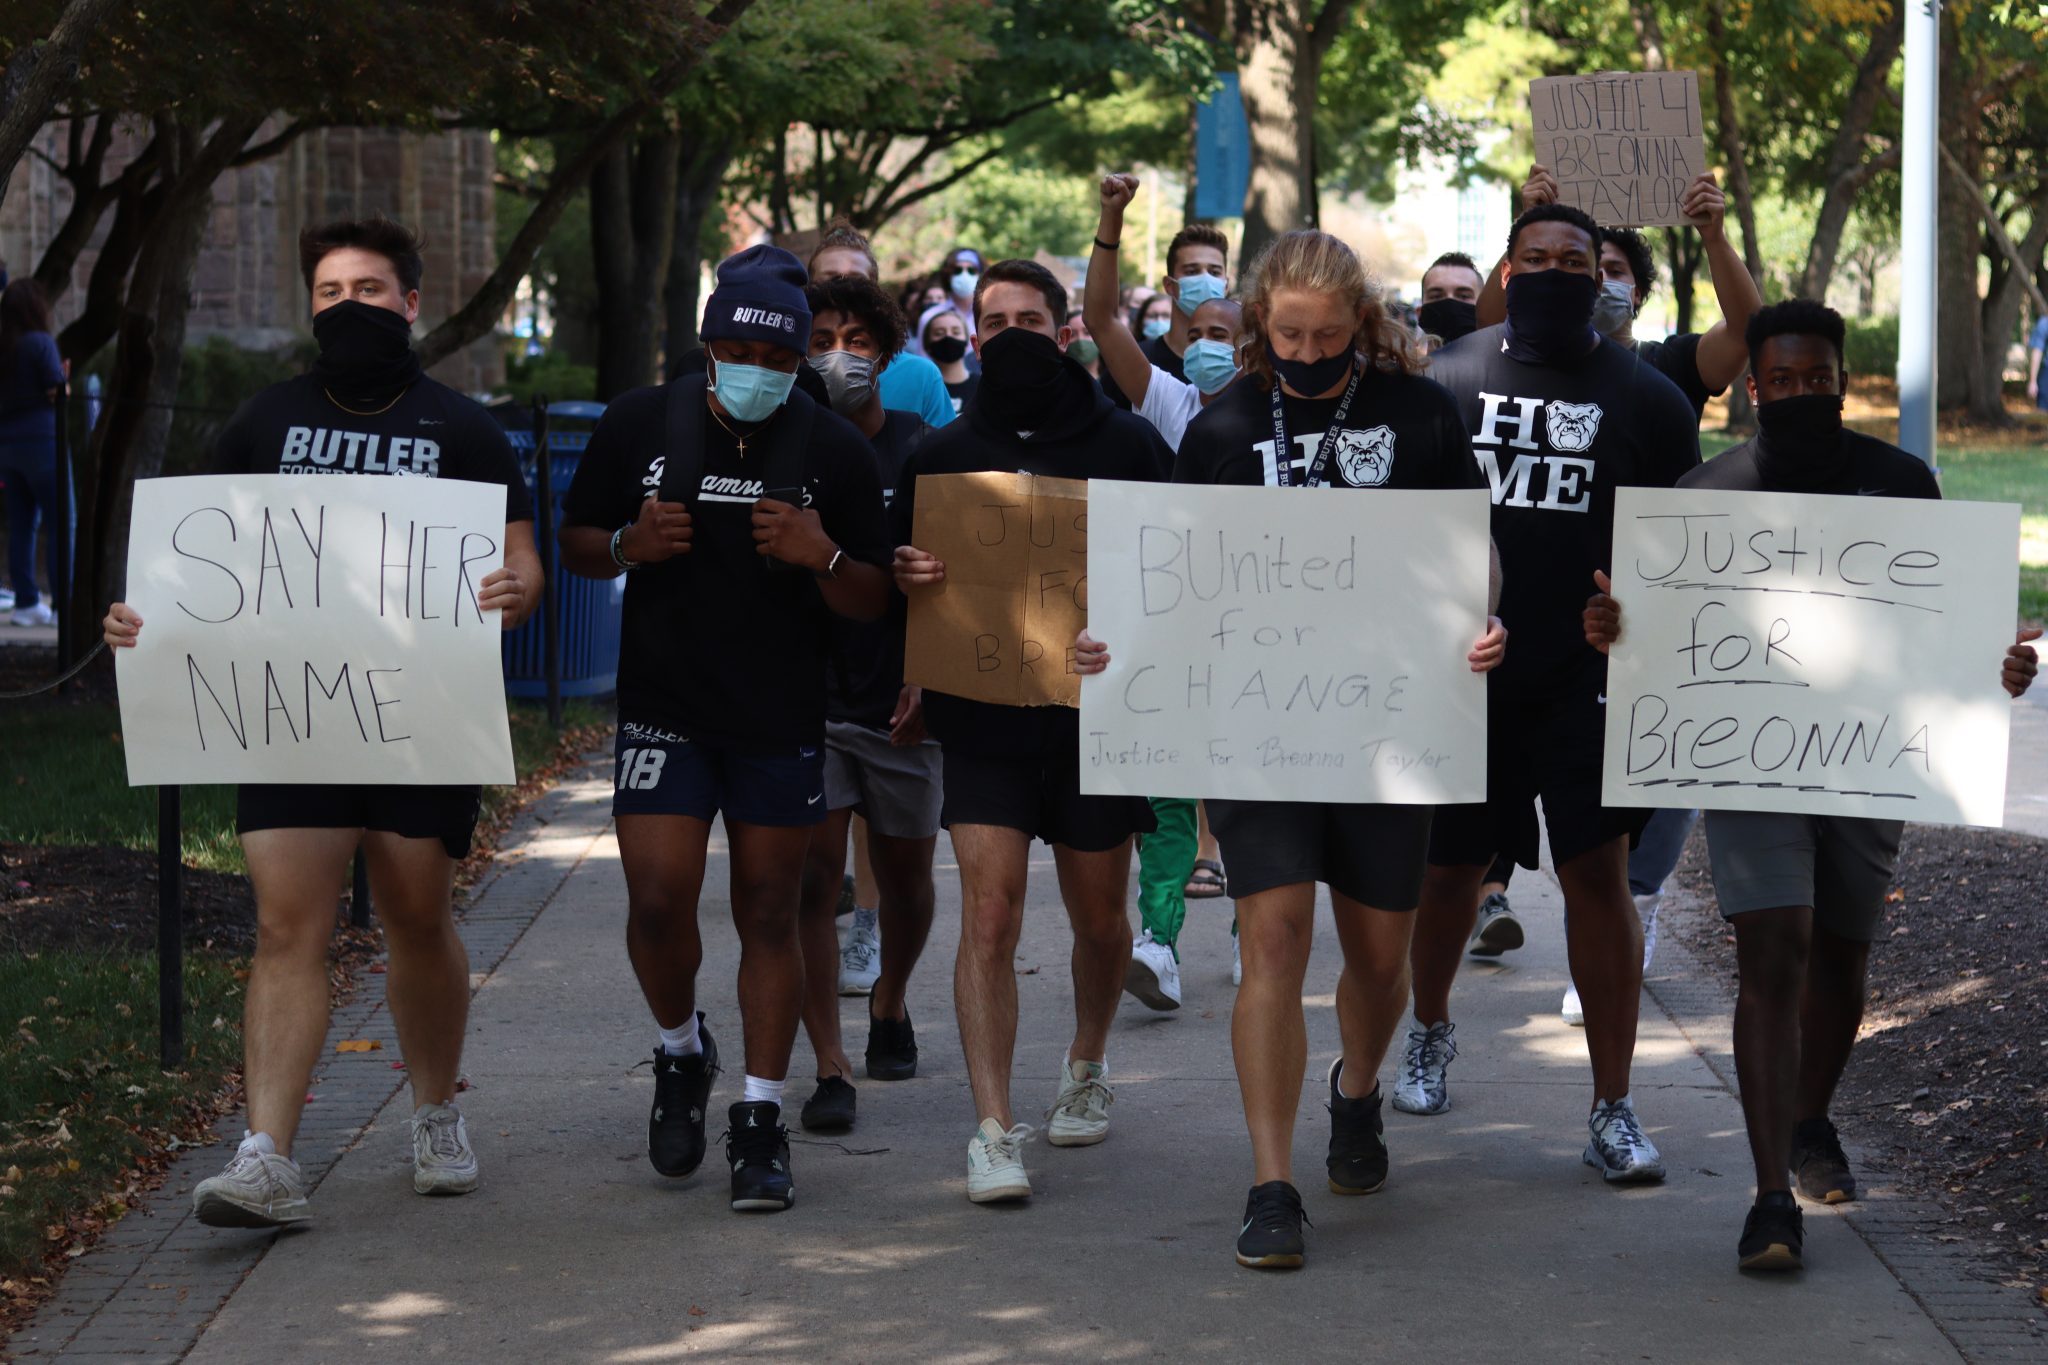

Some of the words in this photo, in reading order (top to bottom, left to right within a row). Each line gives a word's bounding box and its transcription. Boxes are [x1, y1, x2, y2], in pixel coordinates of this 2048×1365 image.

[1543, 78, 1650, 132] JUSTICE
[1658, 77, 1692, 138] 4
[1552, 133, 1691, 178] BREONNA
[1562, 175, 1687, 225] TAYLOR
[732, 306, 783, 328] BUTLER
[1340, 375, 1359, 411] BUTLER
[1274, 420, 1286, 456] BUTLER
[1319, 424, 1340, 461] BUTLER
[1471, 391, 1545, 451] H
[280, 426, 440, 478] BUTLER
[1472, 449, 1596, 513] ME
[173, 505, 324, 623] SAY
[379, 511, 496, 627] HER
[1140, 525, 1355, 617] BUnited
[1210, 608, 1317, 651] for
[186, 653, 412, 751] NAME
[1123, 663, 1409, 714] CHANGE
[618, 748, 667, 790] 18
[1089, 731, 1180, 768] Justice
[1206, 738, 1234, 767] For
[1360, 736, 1452, 776] Taylor
